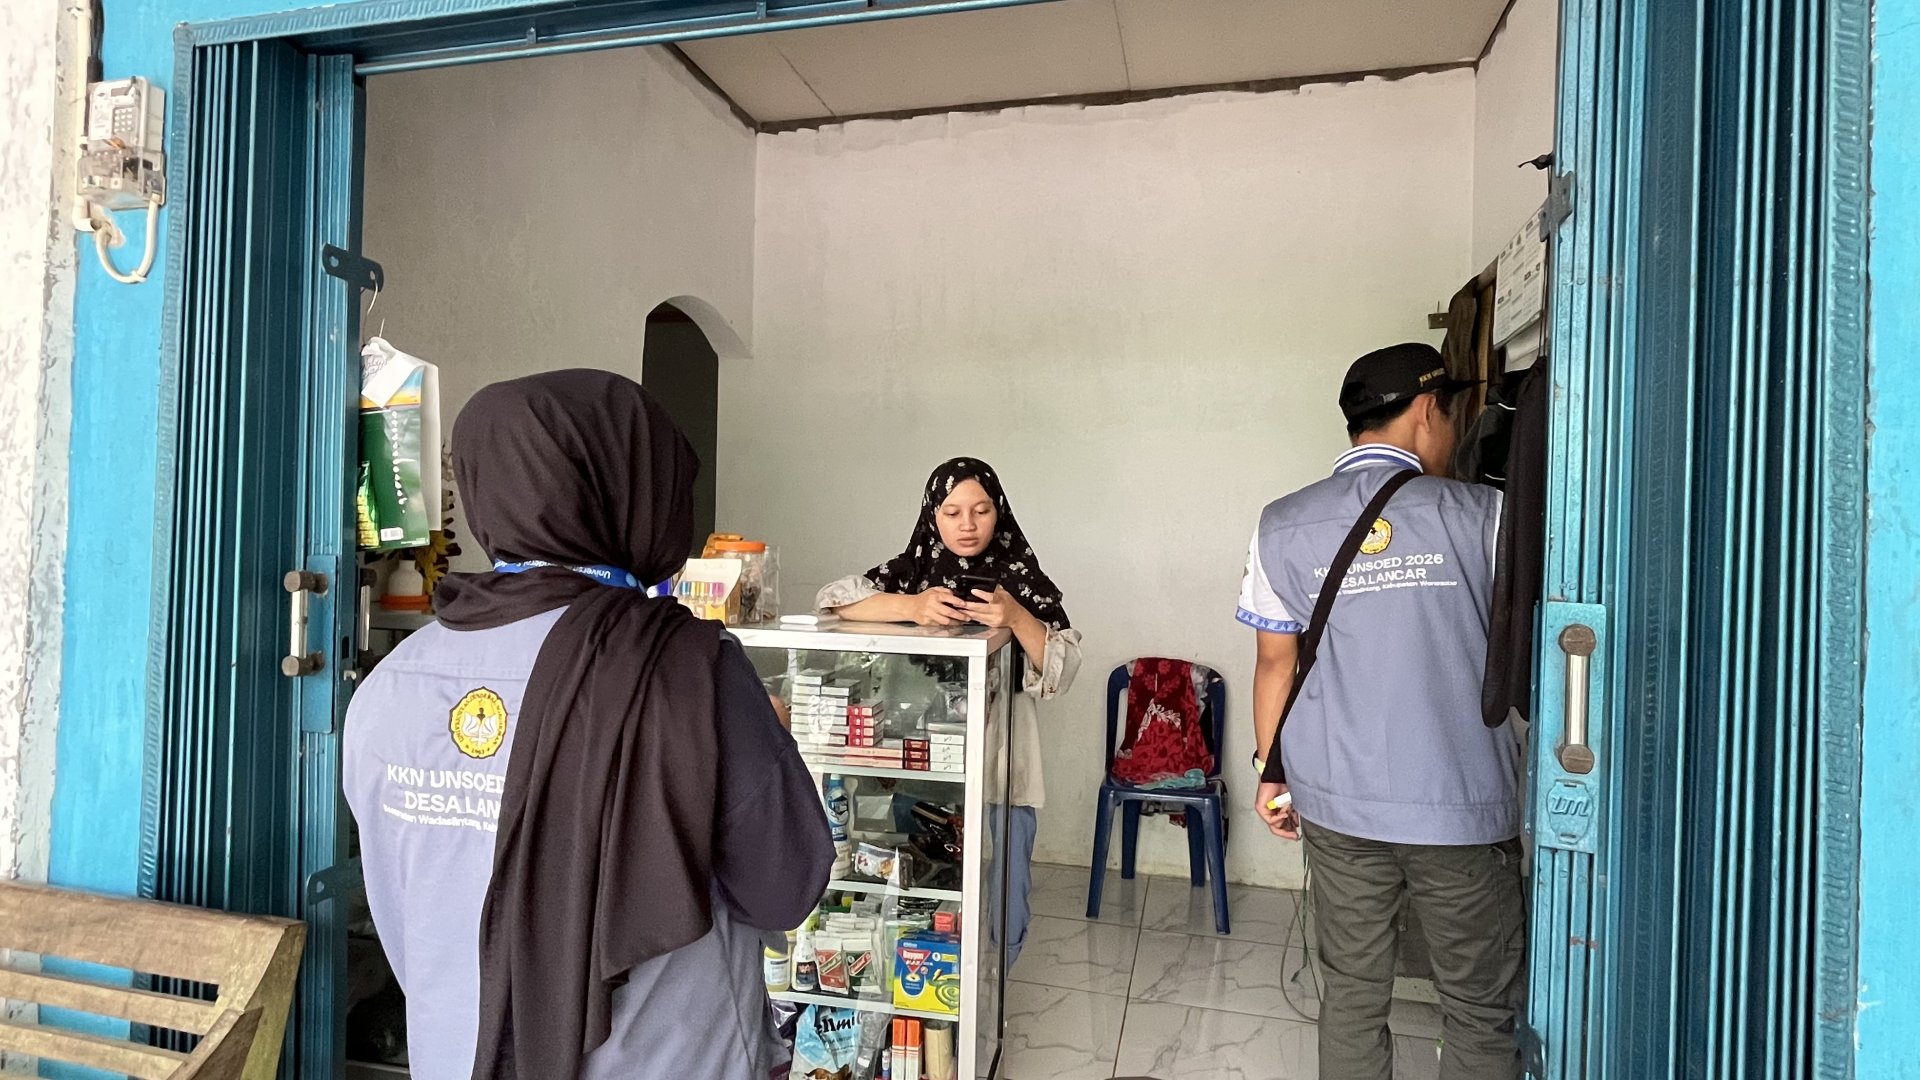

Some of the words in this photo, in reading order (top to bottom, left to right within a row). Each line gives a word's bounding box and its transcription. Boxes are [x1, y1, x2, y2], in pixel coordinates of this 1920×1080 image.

[1347, 557, 1402, 575] UNSOED
[1405, 553, 1444, 566] 2026
[1341, 575, 1366, 589] ESA
[1368, 568, 1426, 586] LANCAR
[387, 763, 424, 788] KKN
[404, 790, 461, 814] DESA
[465, 796, 501, 820] LAN
